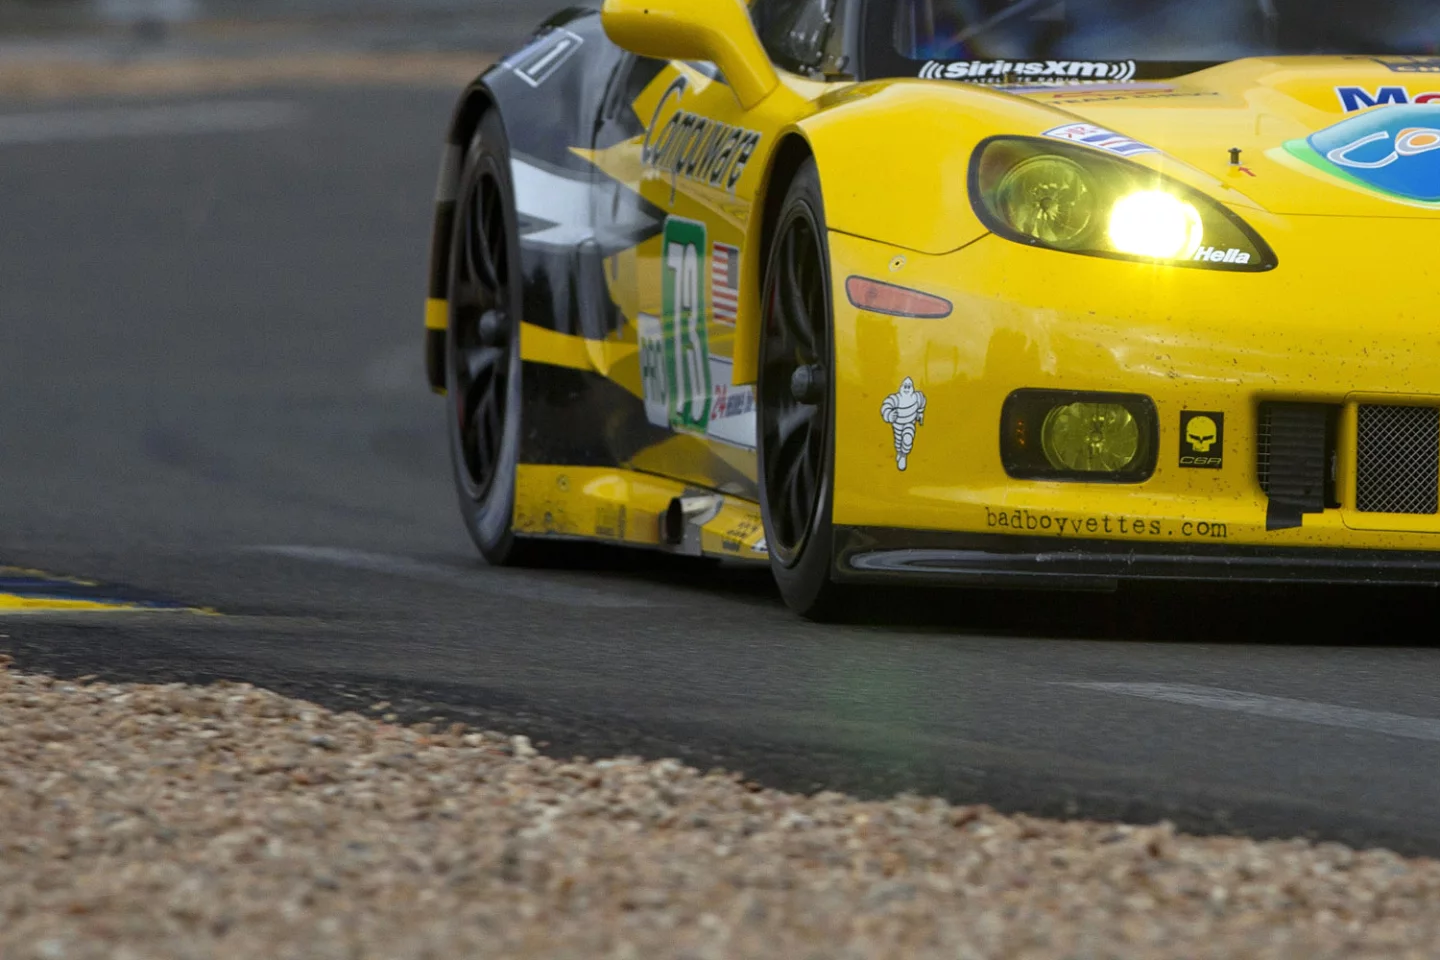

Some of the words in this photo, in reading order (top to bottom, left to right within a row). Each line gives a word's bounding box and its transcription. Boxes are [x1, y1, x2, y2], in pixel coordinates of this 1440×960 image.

[641, 75, 762, 206] Compuware
[1193, 245, 1251, 266] Hella
[985, 507, 1229, 539] badboyvettes.com
